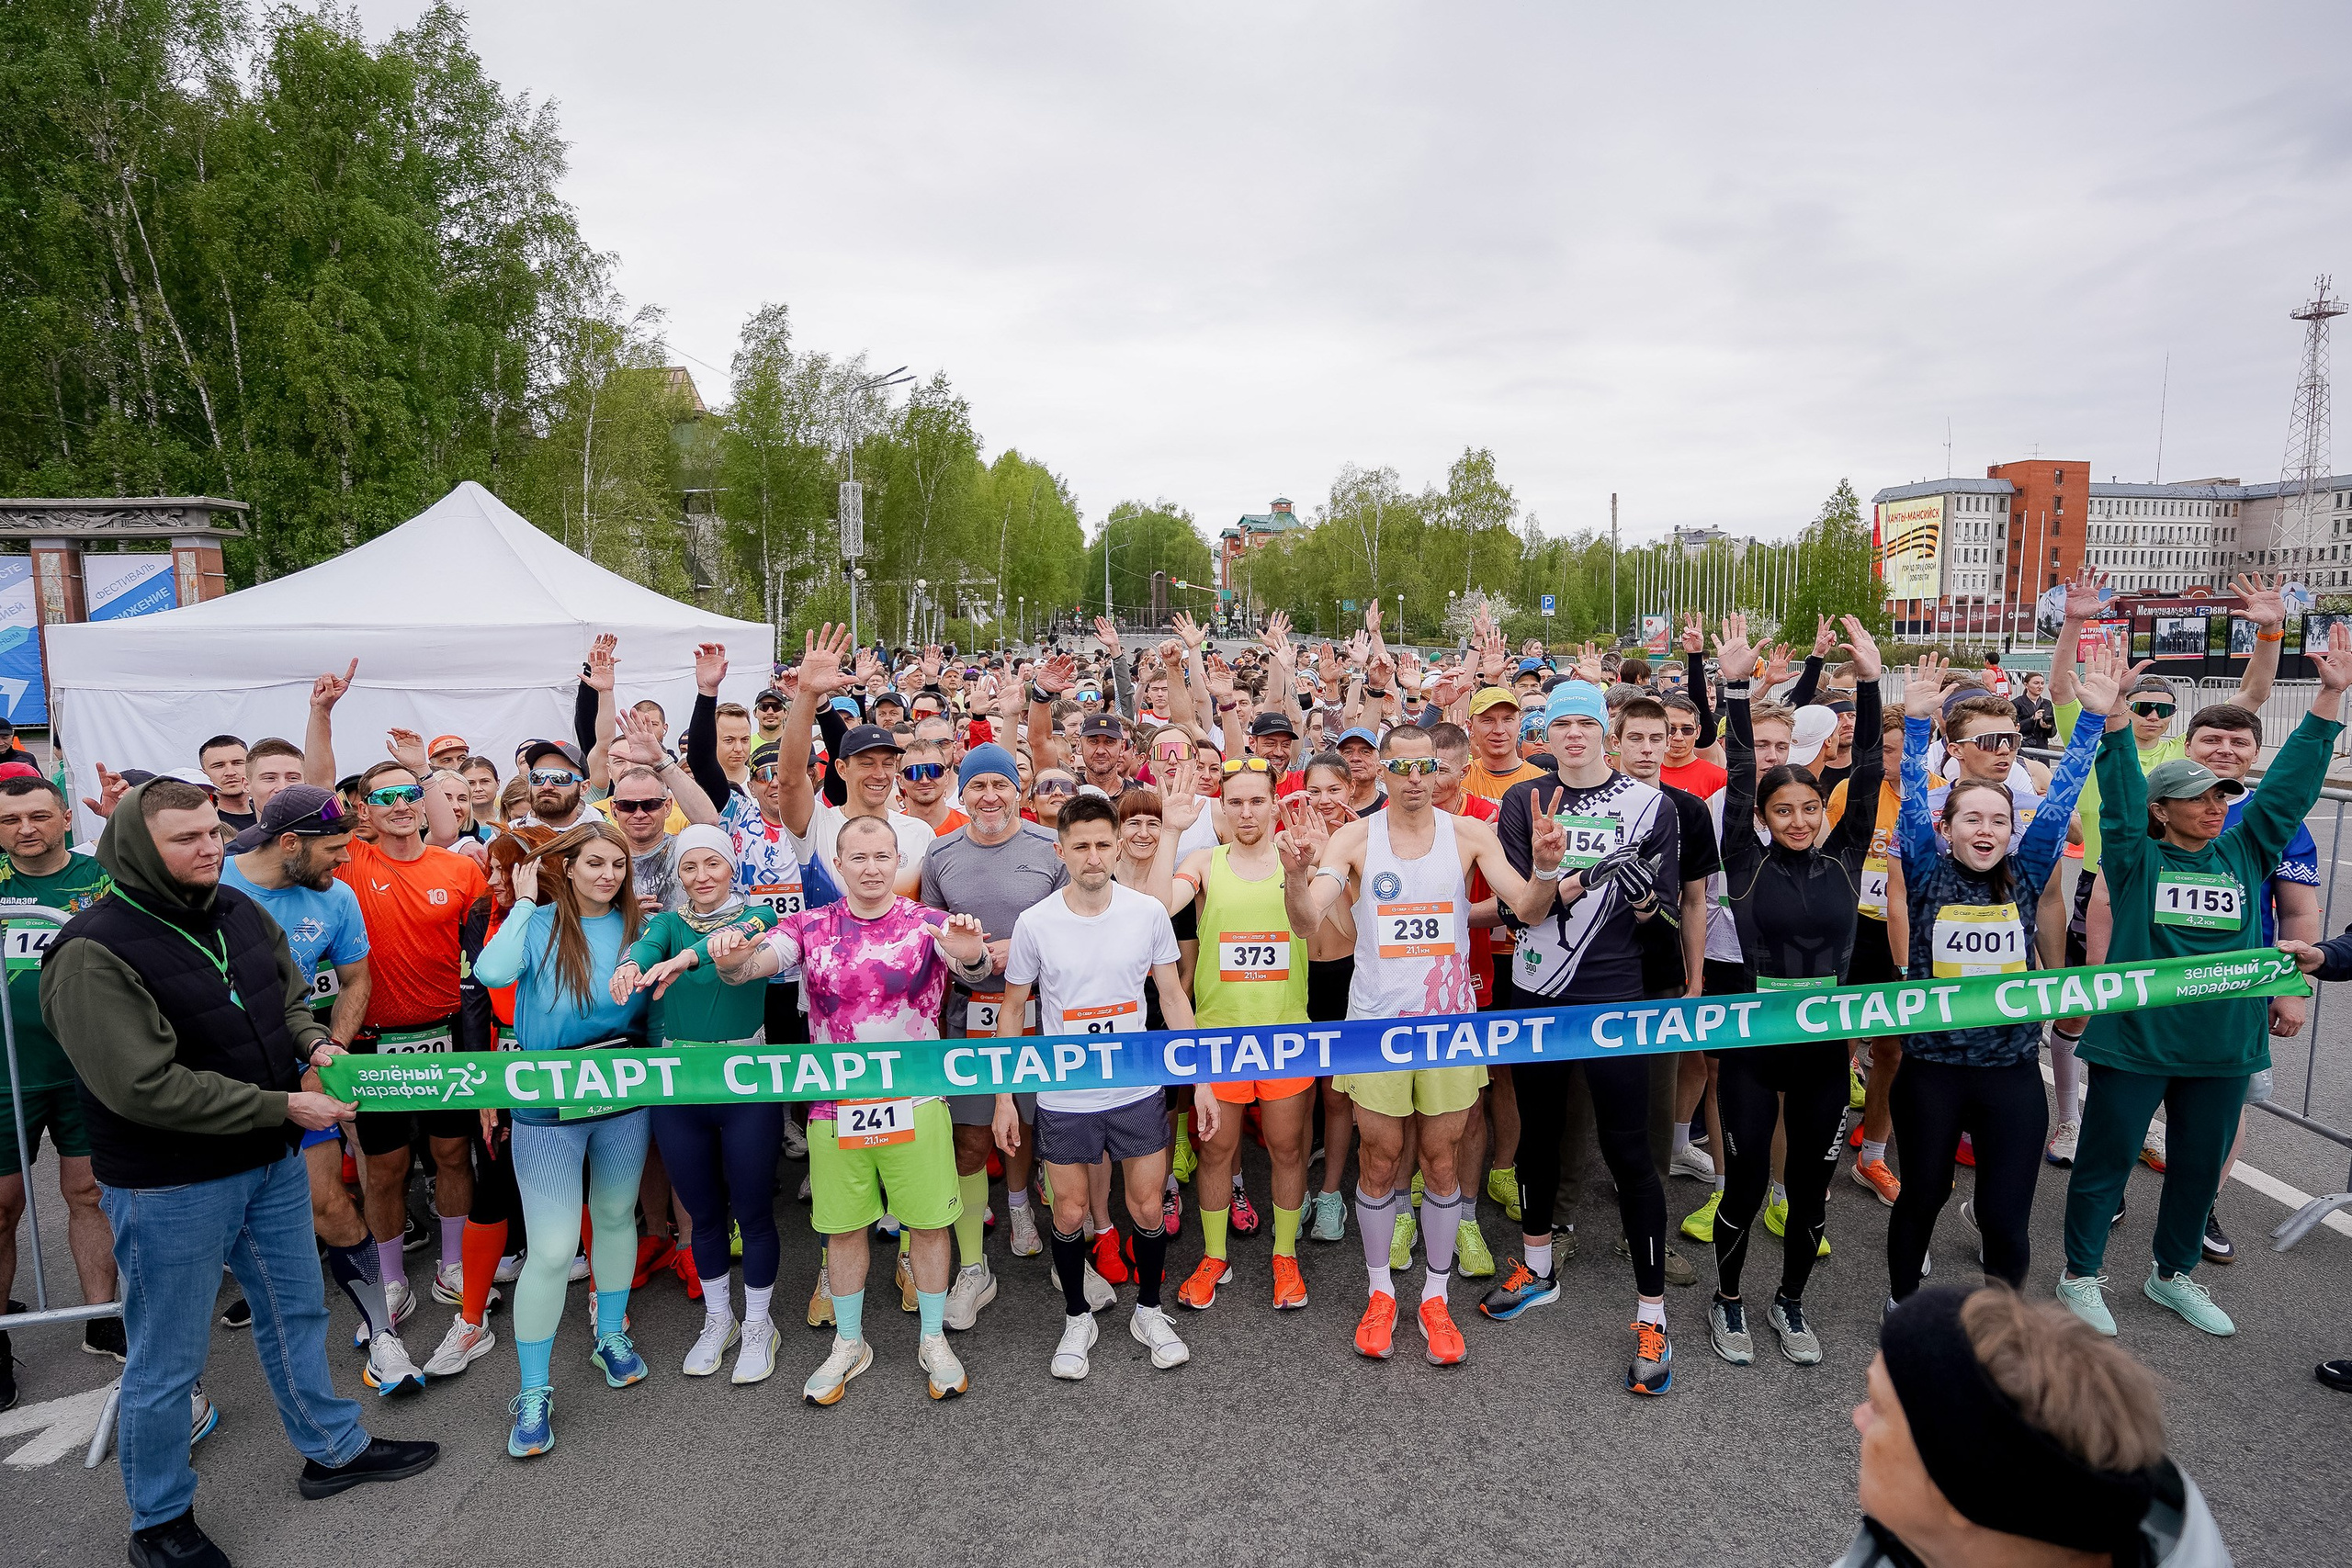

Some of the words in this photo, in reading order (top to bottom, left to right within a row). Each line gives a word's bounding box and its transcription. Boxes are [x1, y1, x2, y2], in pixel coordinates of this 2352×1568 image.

[0, 562, 23, 580] СТЕ
[95, 563, 155, 600] ФЕСТИВАЛЬ
[0, 602, 26, 621] ИЕЙ
[109, 587, 171, 621] ИЖЕНИЕ
[0, 632, 21, 647] НЫМ
[0, 897, 38, 905] ДНАДЗОР
[426, 888, 448, 905] 10
[2167, 887, 2233, 912] 1153
[1394, 919, 1439, 940] 238
[1946, 931, 2015, 953] 4001
[1234, 946, 1276, 965] 373
[2184, 958, 2260, 980] зелёный
[2176, 977, 2252, 998] марафон
[504, 1057, 682, 1101] СТАРТ
[724, 1051, 901, 1095] СТАРТ
[944, 1042, 1123, 1086] СТАРТ
[1163, 1031, 1341, 1077] СТАРТ
[1380, 1017, 1555, 1064] СТАРТ
[1591, 1001, 1762, 1048] СТАРТ
[1795, 985, 1962, 1033] СТАРТ
[1995, 969, 2156, 1018] СТАРТ
[358, 1064, 443, 1082] зелёный
[352, 1082, 439, 1099] марафон
[852, 1106, 895, 1131] 241
